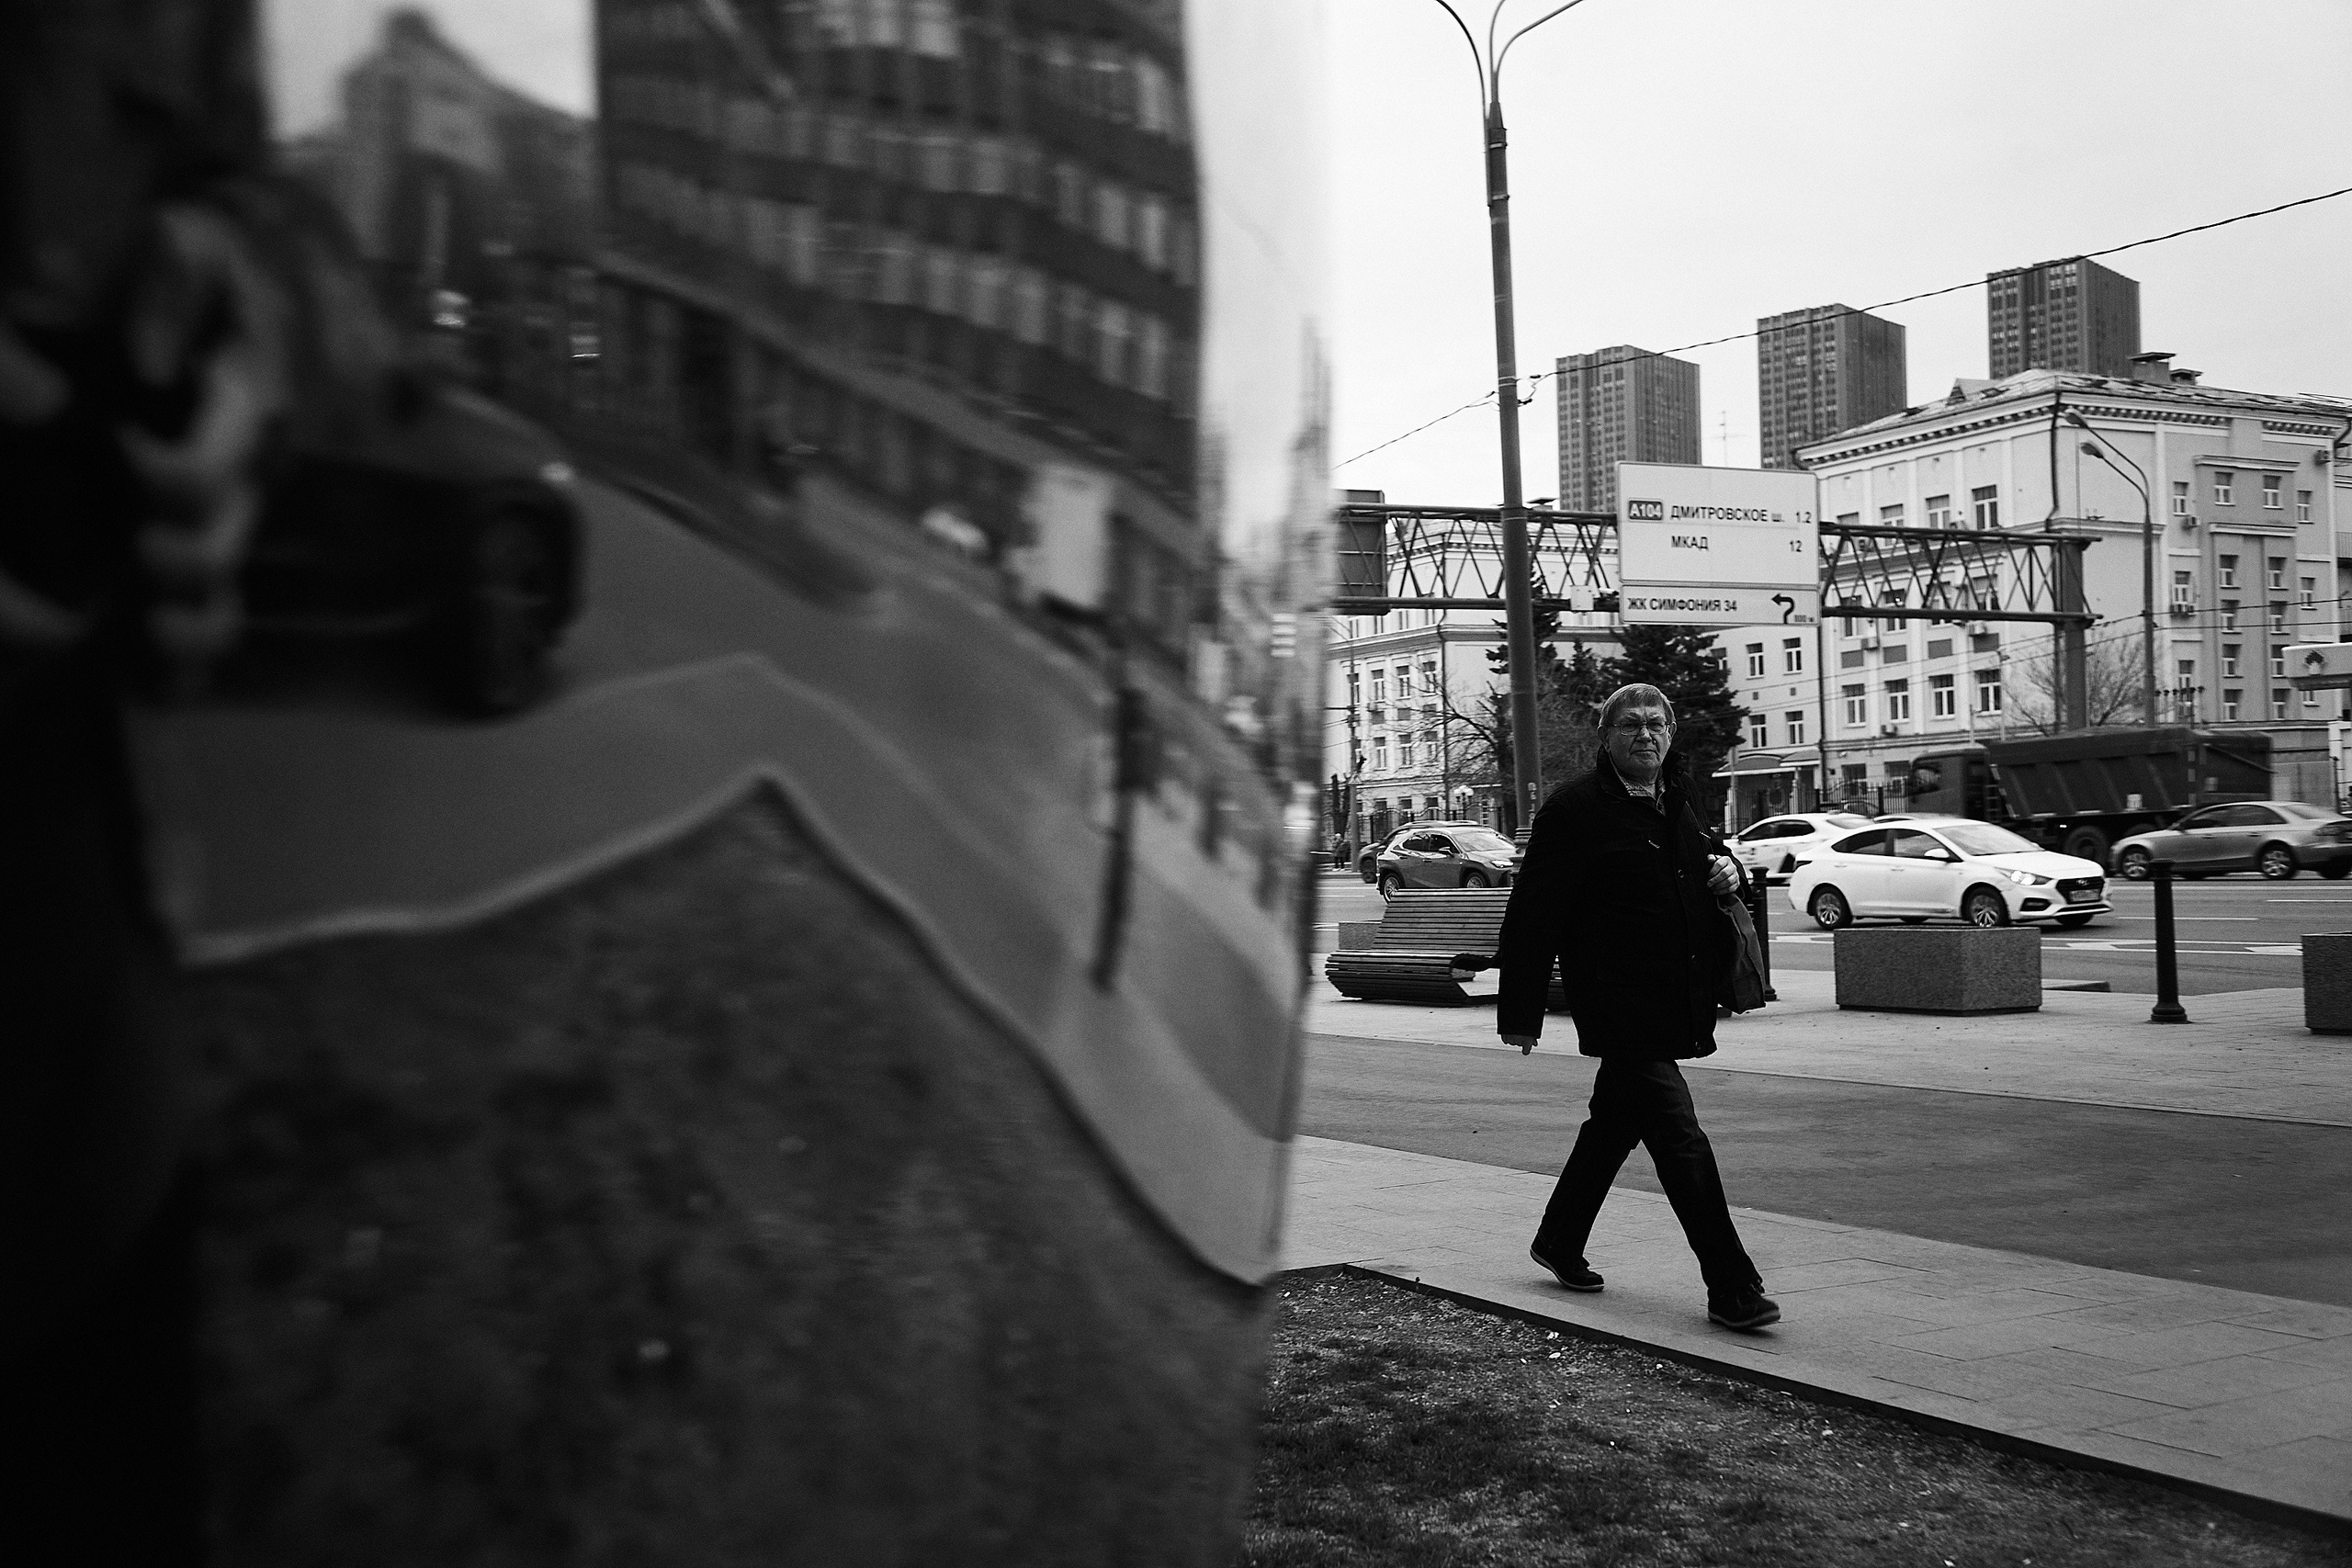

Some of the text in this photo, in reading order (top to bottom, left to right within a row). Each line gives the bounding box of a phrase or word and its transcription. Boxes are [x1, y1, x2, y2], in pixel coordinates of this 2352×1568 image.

[1630, 503, 1662, 518] А104
[1670, 505, 1768, 522] ДМИТРОВСКОЕ
[1671, 536, 1803, 552] МКАД 12
[1627, 598, 1737, 612] ЖК СИМФОНИЯ 34
